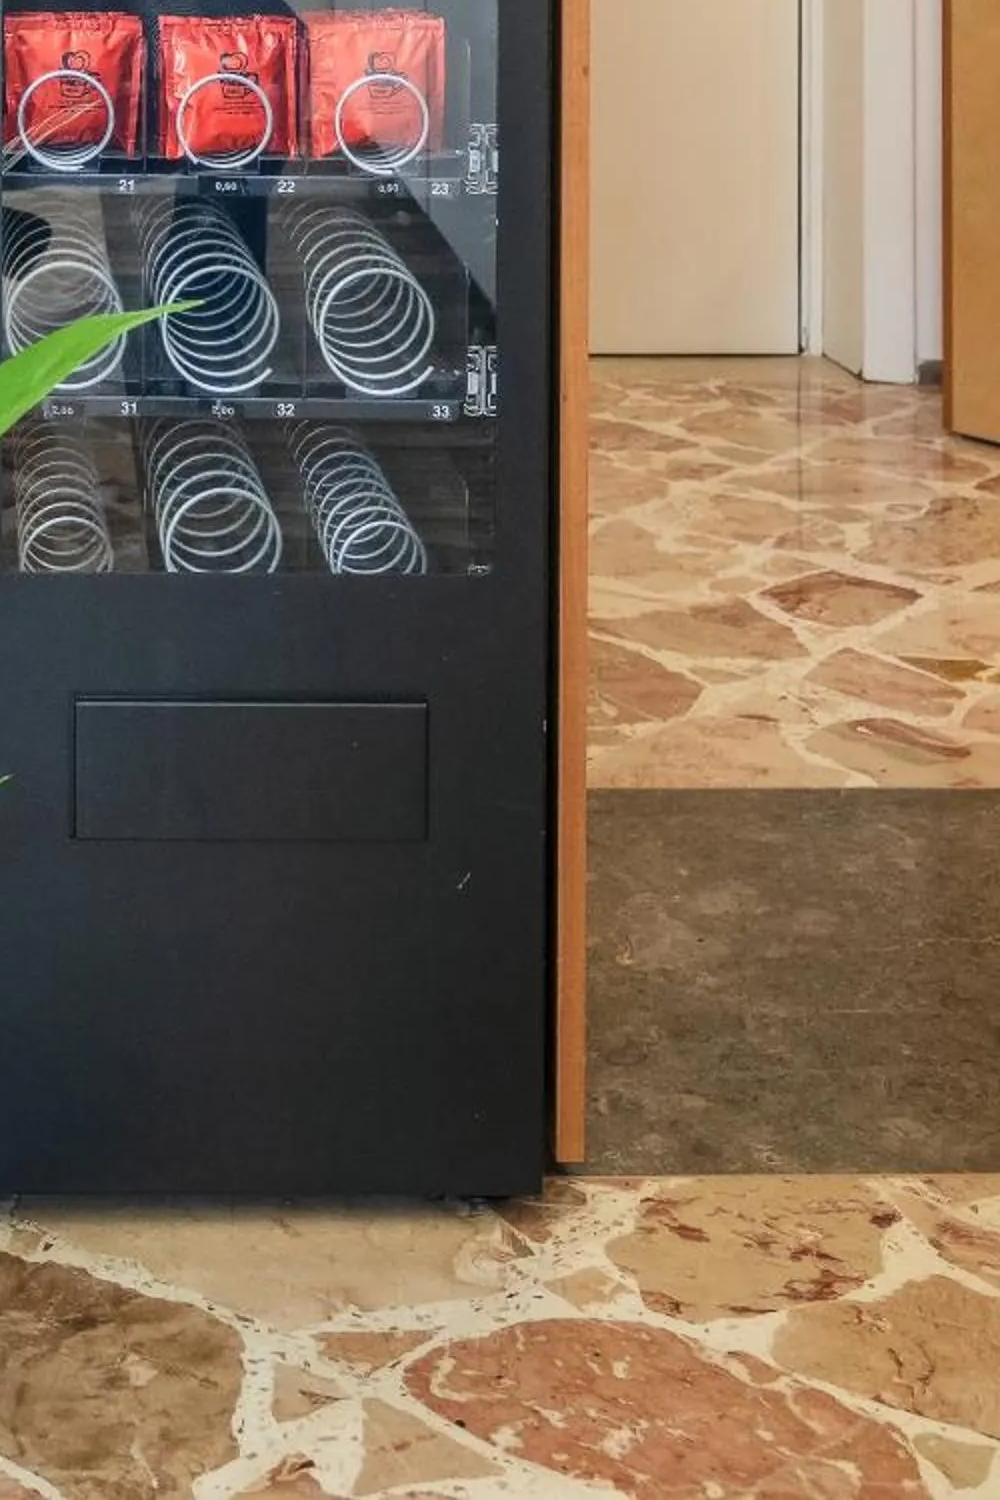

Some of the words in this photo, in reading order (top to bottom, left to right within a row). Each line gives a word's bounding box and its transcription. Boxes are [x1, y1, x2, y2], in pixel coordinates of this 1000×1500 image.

[118, 180, 136, 192] 21
[277, 181, 296, 193] 22
[431, 183, 449, 195] 23
[120, 402, 137, 415] 31
[277, 403, 296, 417] 32
[432, 405, 450, 419] 33
